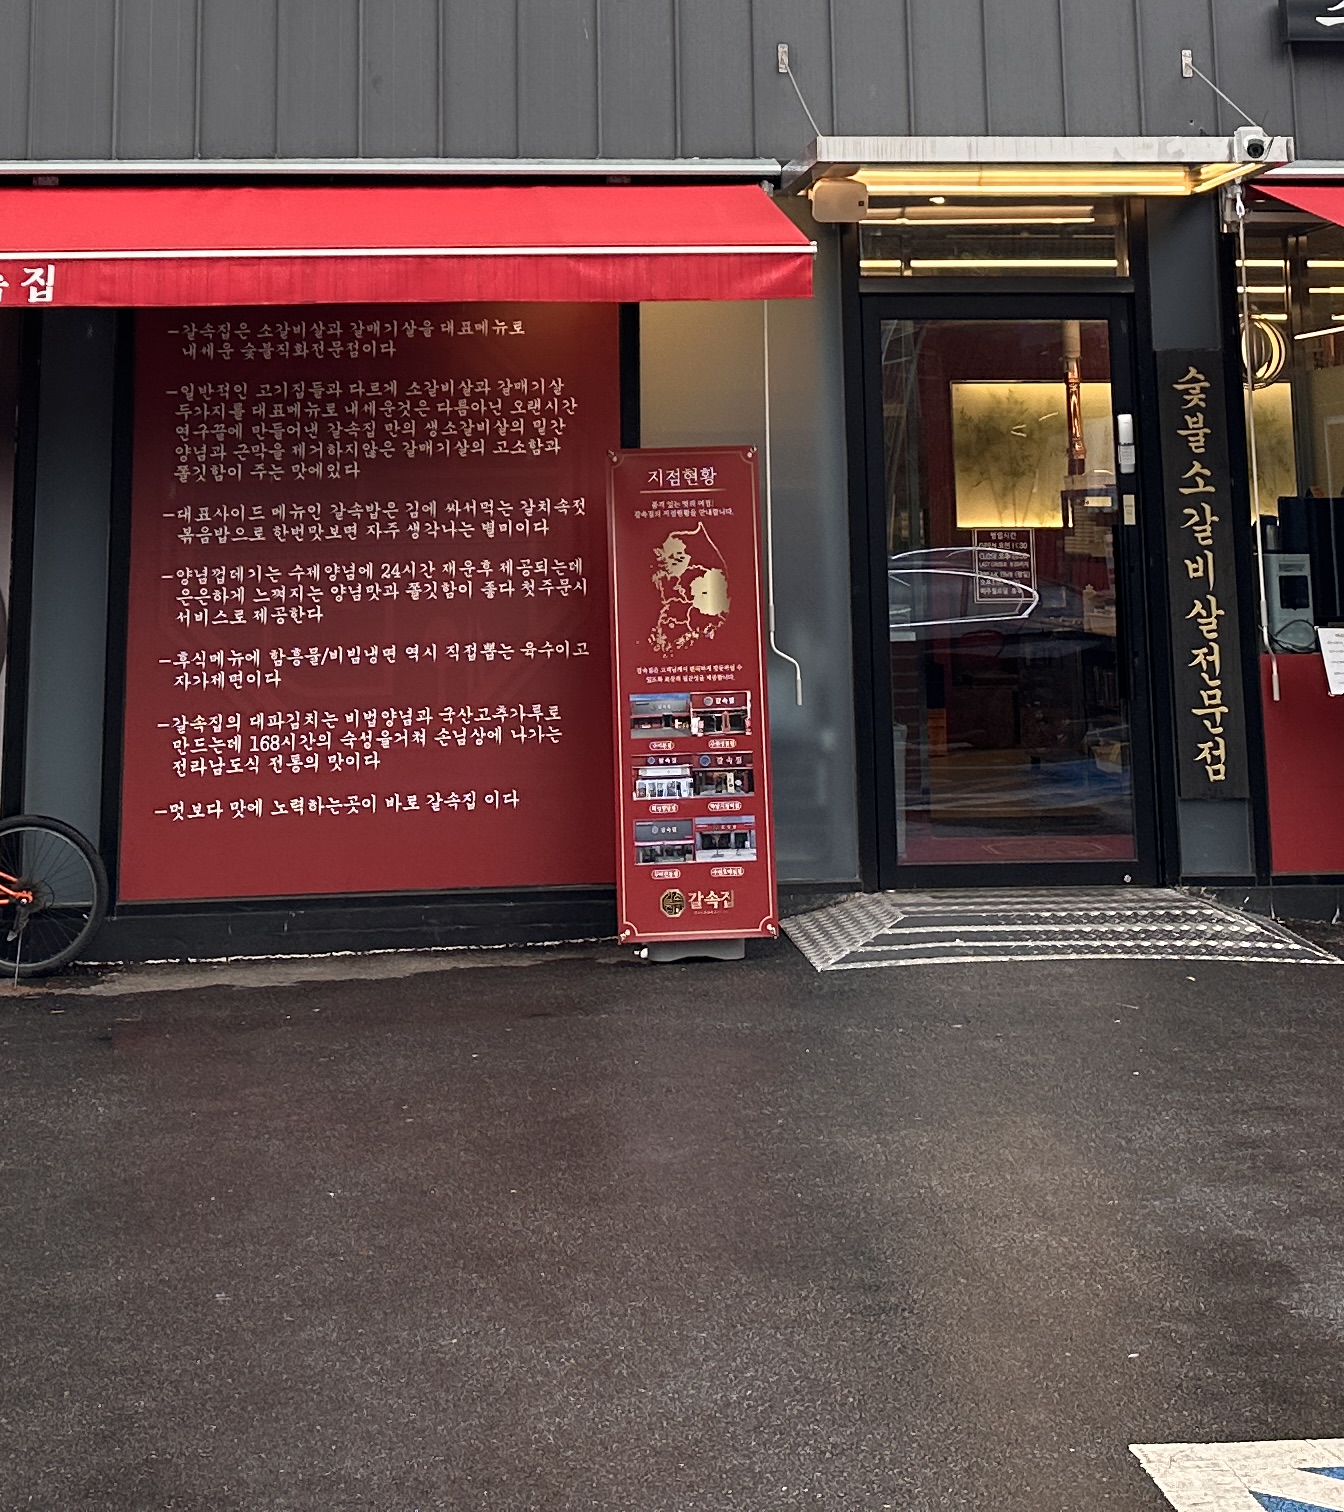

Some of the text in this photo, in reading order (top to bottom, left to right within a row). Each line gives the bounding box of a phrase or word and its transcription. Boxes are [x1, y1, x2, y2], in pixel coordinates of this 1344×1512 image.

[257, 319, 525, 339] 소갈비살과 갈매기살을 대표메뉴로
[182, 340, 396, 360] 내세운 숯불직화전문점이다
[256, 378, 564, 399] 고기집들과 다르게 소갈비살과 갈매기살
[175, 397, 578, 421] 두가지를 대표메뉴로 내세운것은 다름아닌 오랜시간
[252, 422, 318, 440] 만들어낸
[424, 418, 524, 437] 생소갈비살의
[175, 443, 227, 463] 양념과
[233, 442, 285, 461] 근막을
[403, 439, 485, 458] 갈매기살의
[493, 438, 561, 456] 고소함과
[250, 463, 285, 481] 주는
[648, 467, 717, 487] 지점현황
[272, 503, 321, 521] 메뉴인
[330, 502, 399, 520] 갈속밥은
[406, 500, 436, 519] 김에
[445, 499, 513, 518] 싸서먹는
[520, 498, 586, 517] 갈치속젓
[178, 518, 549, 545] 볶음밥으로 한번맛보면 자주 생각나는 별미이다
[288, 562, 373, 582] 수제양념에
[381, 560, 436, 579] 24시간
[442, 560, 493, 578] 재운후
[499, 558, 582, 577] 제공되는데
[1172, 365, 1230, 783] 숯불소갈비살전문점
[176, 578, 586, 606] 은은하게 느껴지는 양념맛과 쫄깃함이 좋다 첫주문시
[175, 605, 323, 628] 서비스로 제공한다
[406, 643, 436, 662] 역시
[520, 640, 589, 659] 육수이고
[173, 669, 281, 691] 자가제면이다
[250, 704, 562, 731] 대파김치는 비법양념과 국산고추가루로
[173, 725, 562, 755] 만드는데 168시간의 숙성을거쳐 손님상에 나가는
[173, 750, 380, 777] 전라남도식 전통의 맛이다
[230, 789, 519, 819] 맛에 노력하는곳이 바로 갈속집 이다
[688, 890, 735, 910] 갈속집
